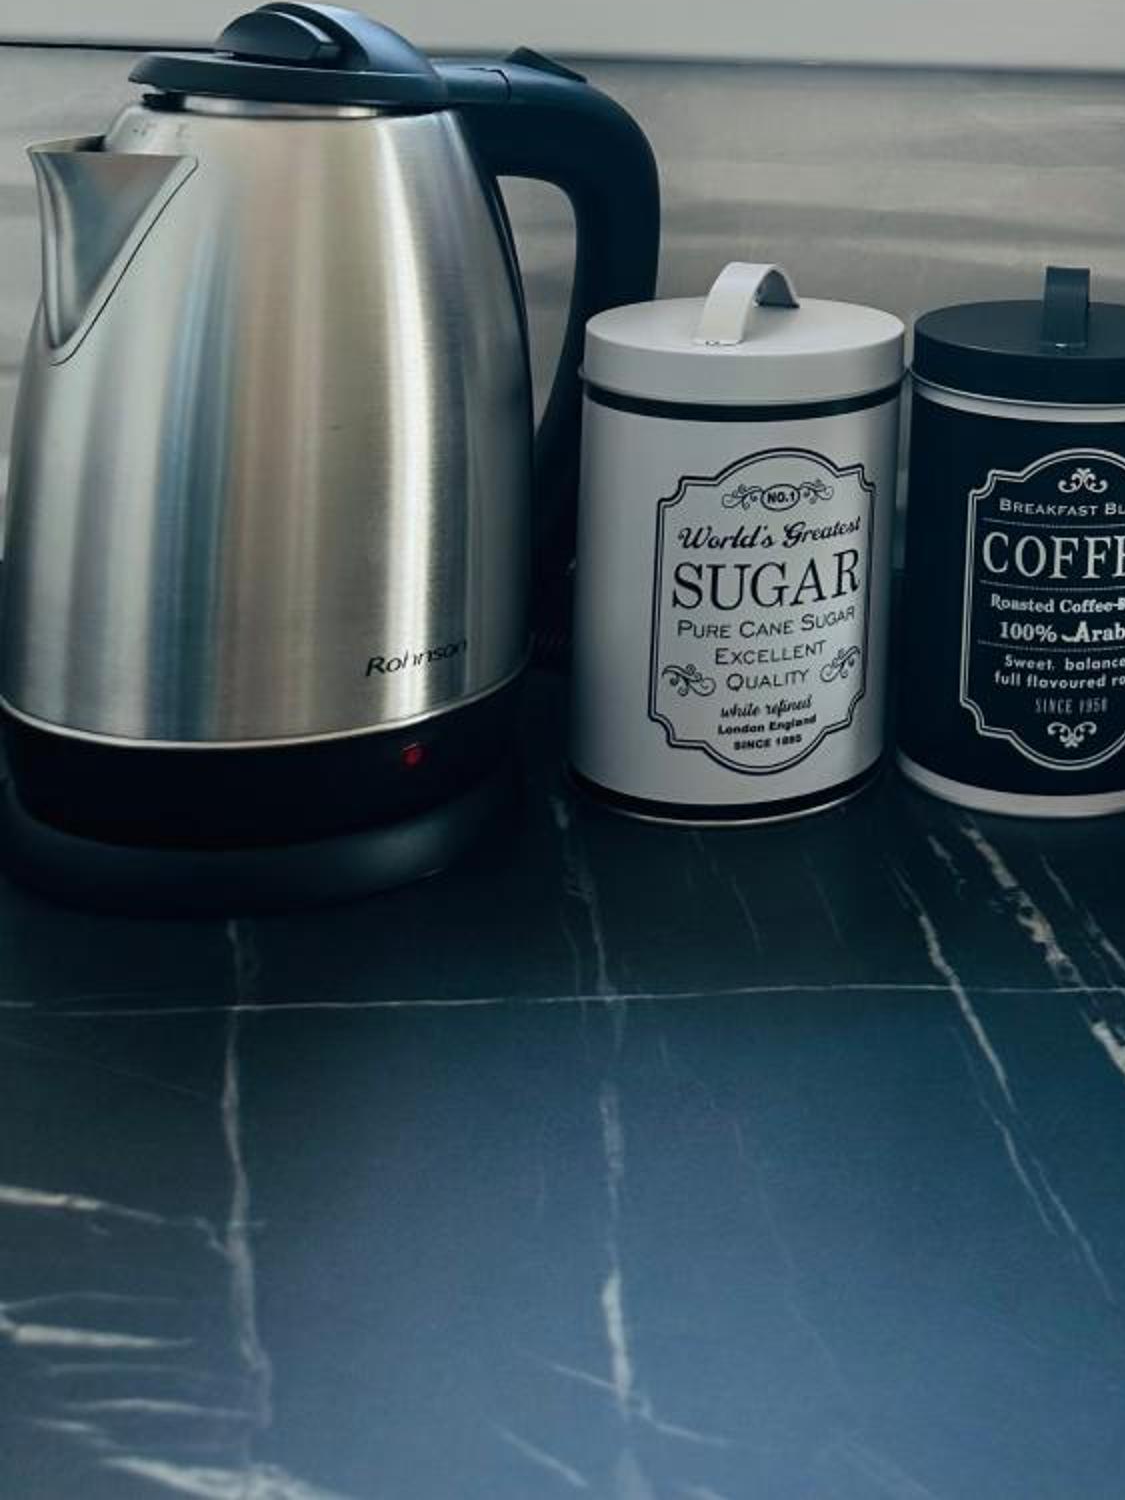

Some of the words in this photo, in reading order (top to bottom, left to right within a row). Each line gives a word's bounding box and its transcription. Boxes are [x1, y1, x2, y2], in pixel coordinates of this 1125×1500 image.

[678, 525, 776, 550] World's
[783, 516, 862, 549] Greatest
[672, 548, 861, 611] SUGAR
[990, 593, 1055, 614] Roasted
[999, 621, 1058, 643] 100%
[994, 669, 1022, 687] full
[1026, 675, 1107, 689] flavoured
[720, 702, 760, 719] white
[1035, 697, 1073, 715] SINCE
[717, 723, 765, 736] London
[769, 714, 817, 736] England
[733, 737, 772, 751] SINCE
